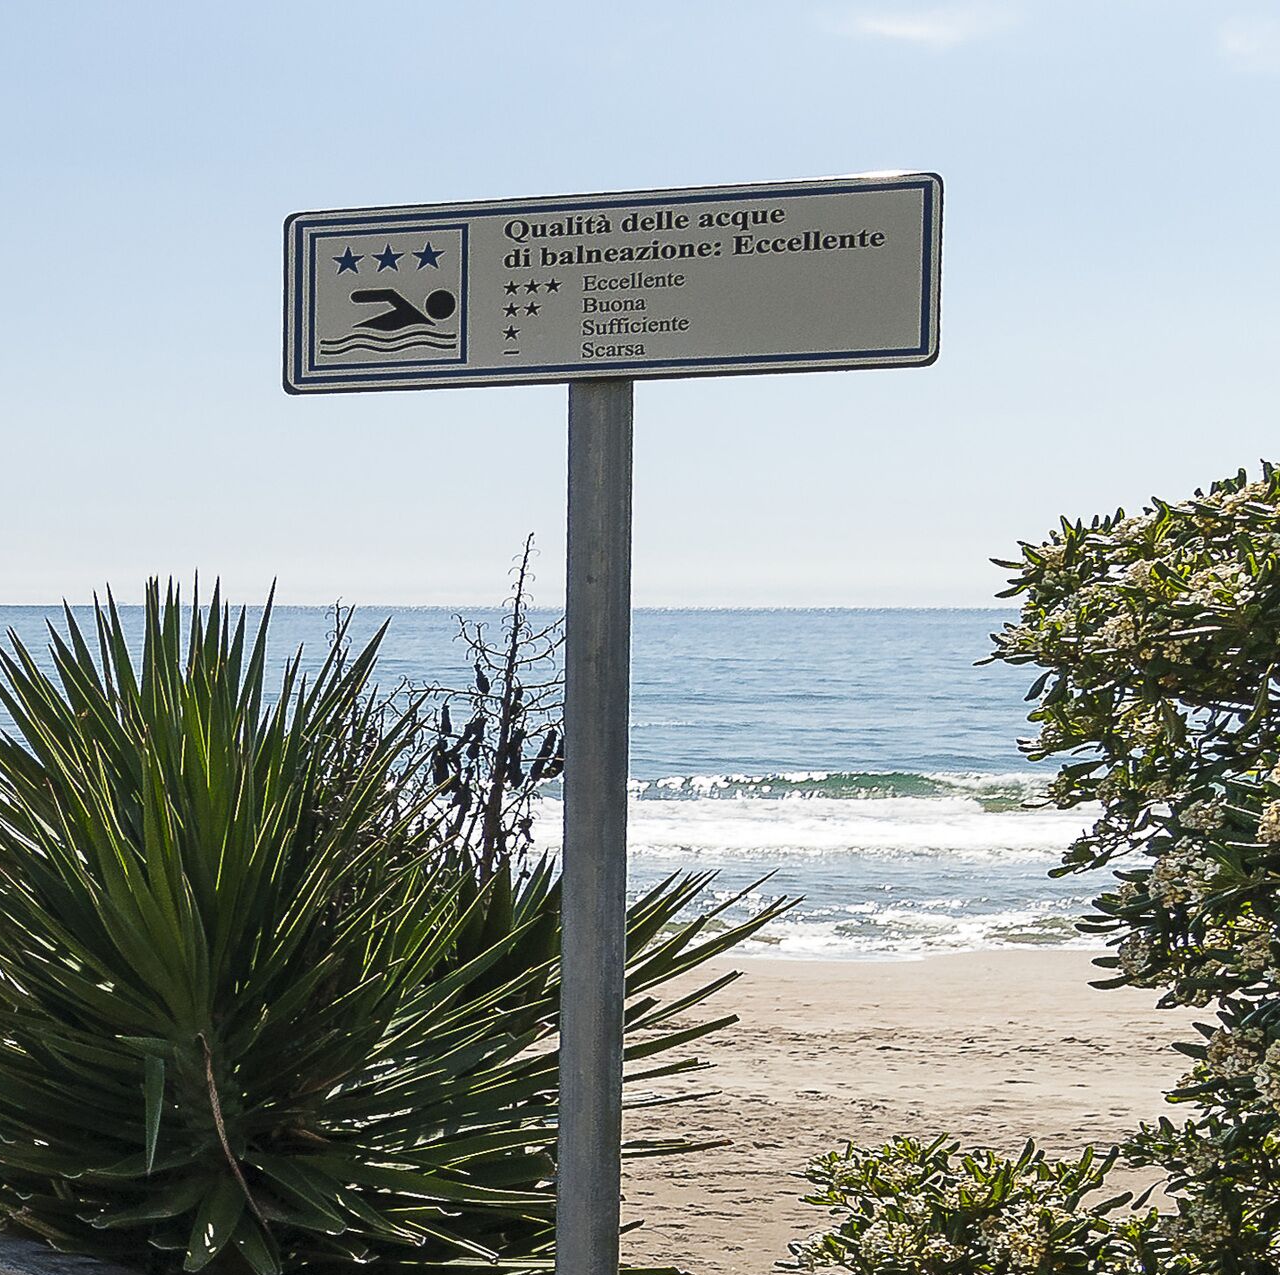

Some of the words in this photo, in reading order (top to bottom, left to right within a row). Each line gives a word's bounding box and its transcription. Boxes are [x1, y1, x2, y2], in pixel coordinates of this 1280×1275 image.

[504, 211, 612, 243] Qualità
[621, 209, 690, 234] delle
[698, 206, 786, 230] acque
[504, 247, 532, 270] di
[541, 237, 722, 268] balneazione:
[732, 228, 886, 257] Eccellente
[582, 271, 686, 293] Eccellente
[582, 297, 646, 315] Buona
[581, 315, 690, 336] Sufficiente
[581, 341, 646, 359] Scarsa
